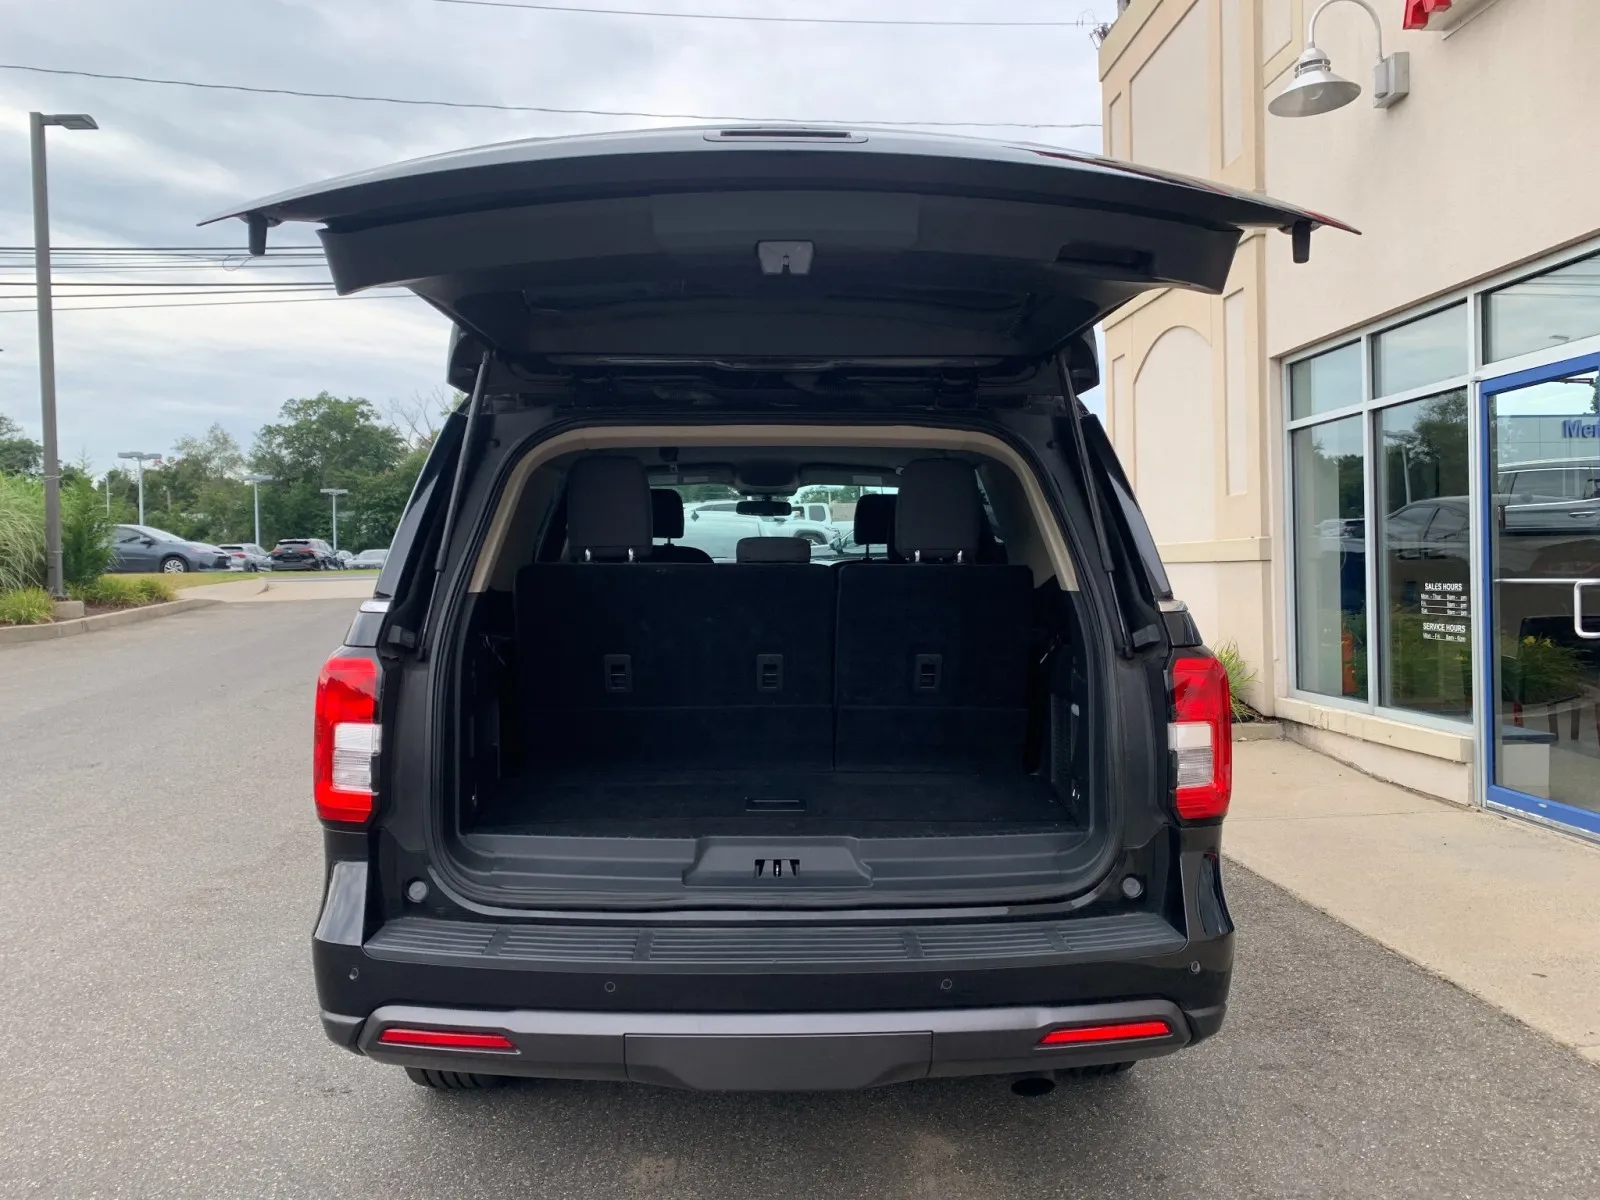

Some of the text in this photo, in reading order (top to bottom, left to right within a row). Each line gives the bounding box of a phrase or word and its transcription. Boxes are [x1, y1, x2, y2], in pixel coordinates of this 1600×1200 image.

[1425, 582, 1462, 591] SALES HOURS
[1423, 622, 1466, 633] SERVICE HOURS
